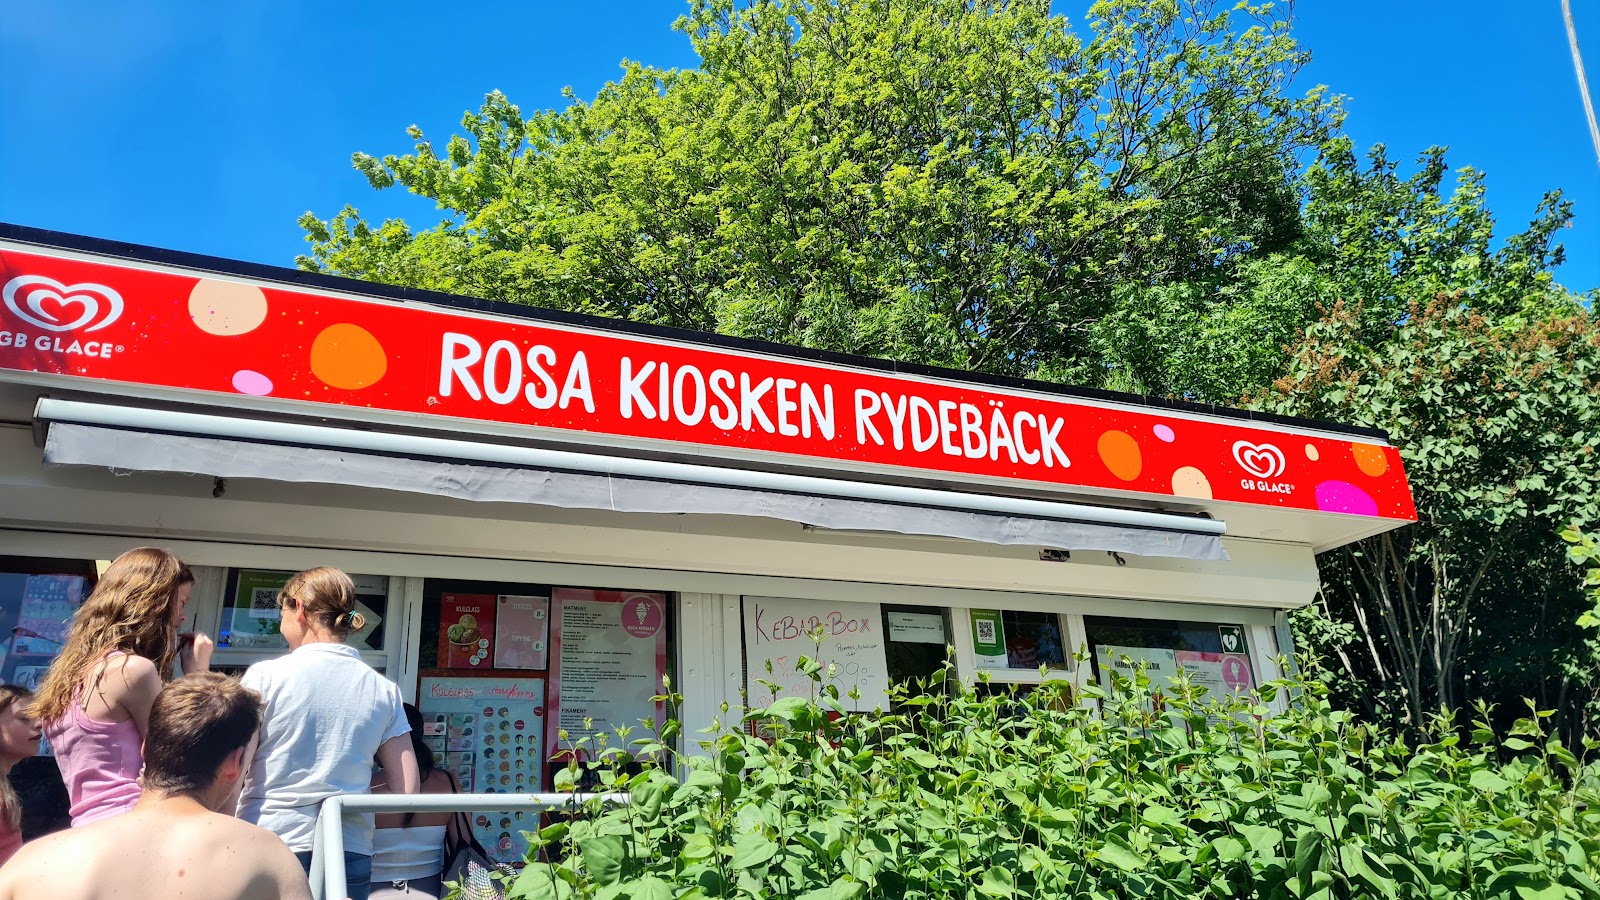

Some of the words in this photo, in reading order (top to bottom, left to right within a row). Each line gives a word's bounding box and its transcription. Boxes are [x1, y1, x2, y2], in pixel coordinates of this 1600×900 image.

[0, 330, 27, 348] GB
[438, 332, 595, 414] ROSA
[619, 356, 835, 441] KIOSKEN
[854, 388, 1071, 468] RYDEBÄCK
[1241, 479, 1255, 490] GB
[431, 683, 474, 698] KULGLASS
